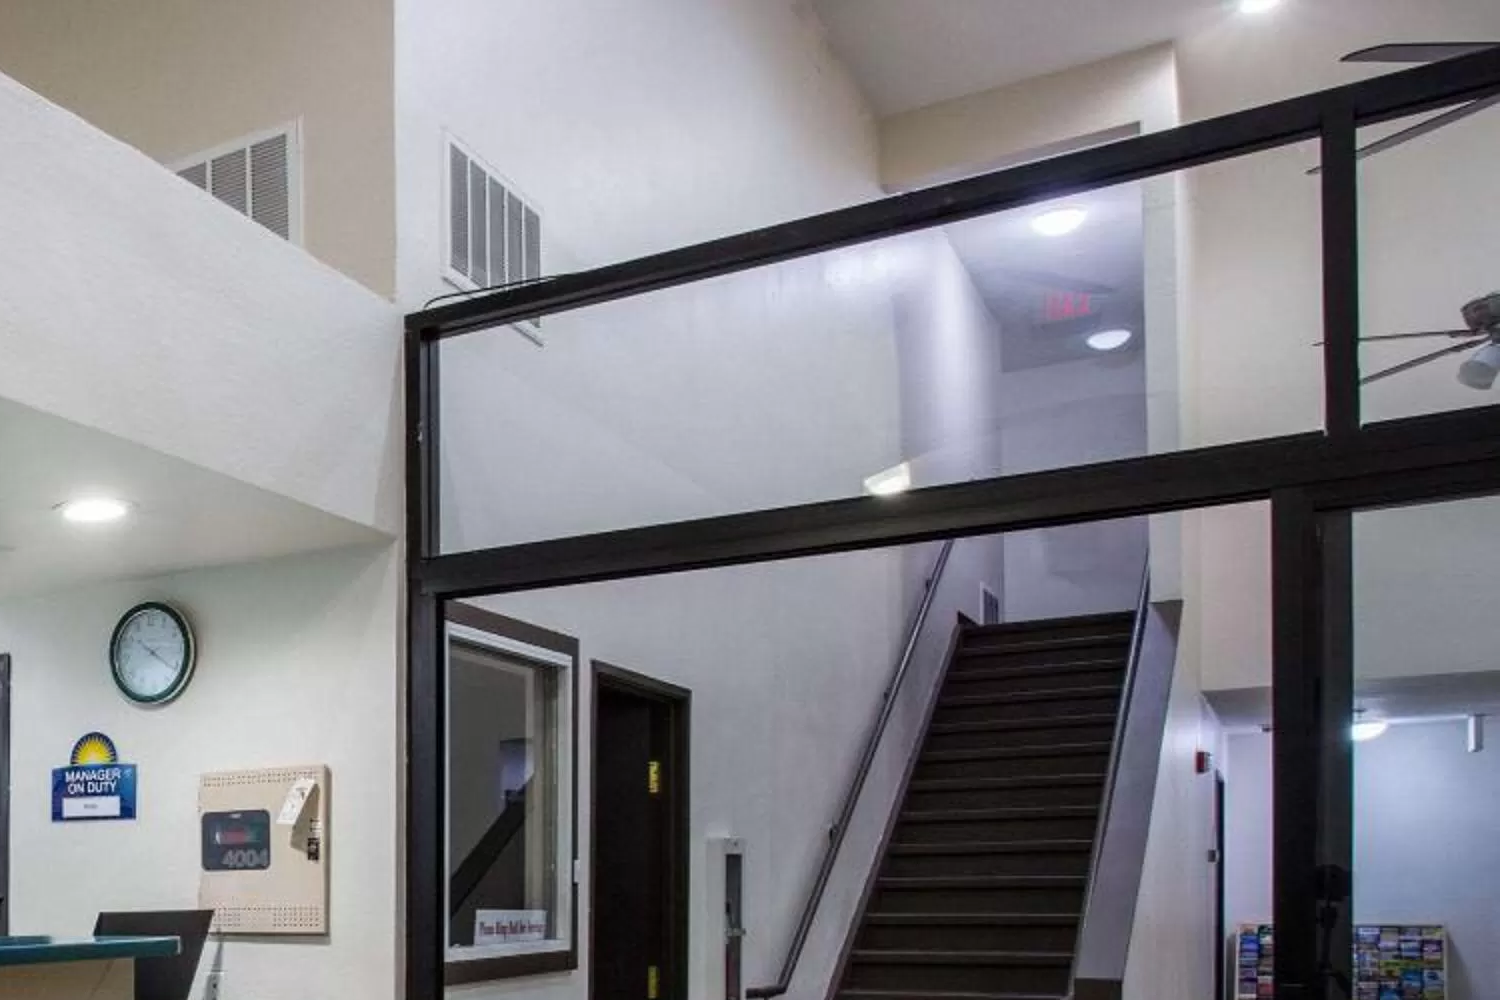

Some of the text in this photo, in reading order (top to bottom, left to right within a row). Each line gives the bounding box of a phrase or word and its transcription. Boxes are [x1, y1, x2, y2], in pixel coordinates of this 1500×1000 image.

[65, 767, 121, 782] MANAGER
[67, 780, 117, 794] ON DUTY
